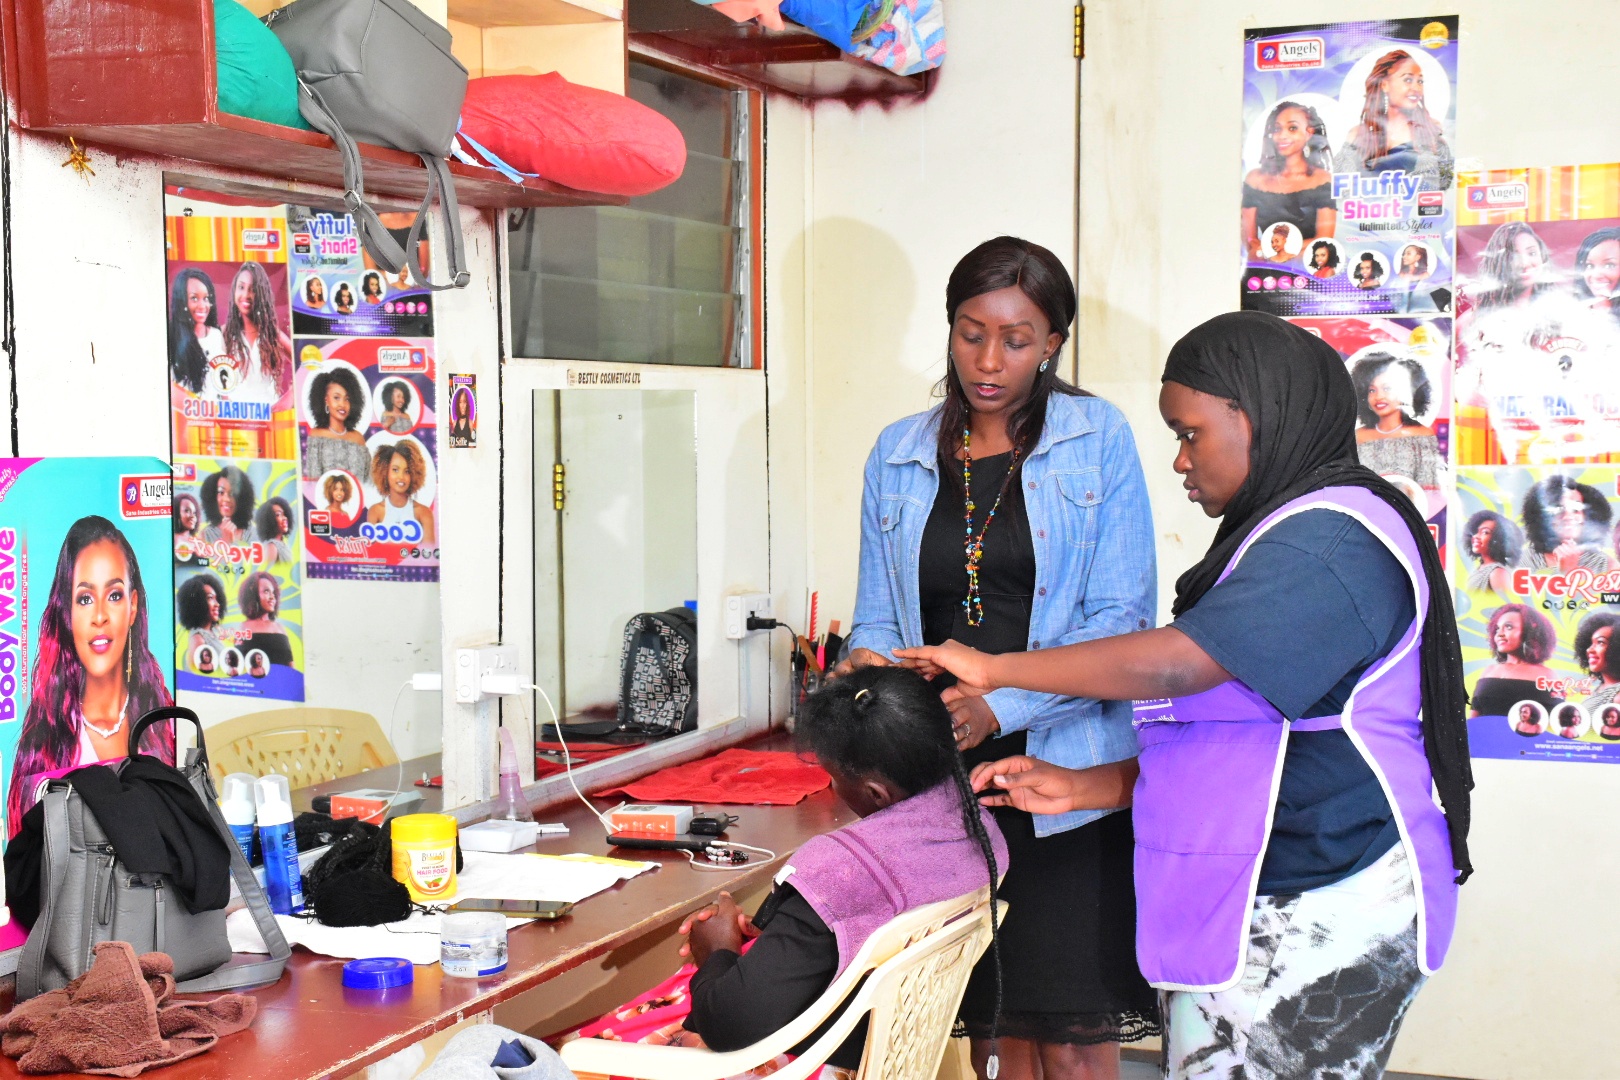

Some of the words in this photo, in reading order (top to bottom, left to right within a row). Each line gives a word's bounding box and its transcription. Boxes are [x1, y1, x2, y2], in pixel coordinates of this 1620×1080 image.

[1281, 43, 1317, 57] Angels
[1332, 171, 1419, 201] Fluffy
[1489, 187, 1522, 198] Angels
[1343, 199, 1402, 219] Short
[1359, 221, 1401, 232] Unlimited
[1401, 219, 1433, 234] Styles
[578, 372, 599, 385] BESTLY
[600, 372, 630, 385] COSMETICS
